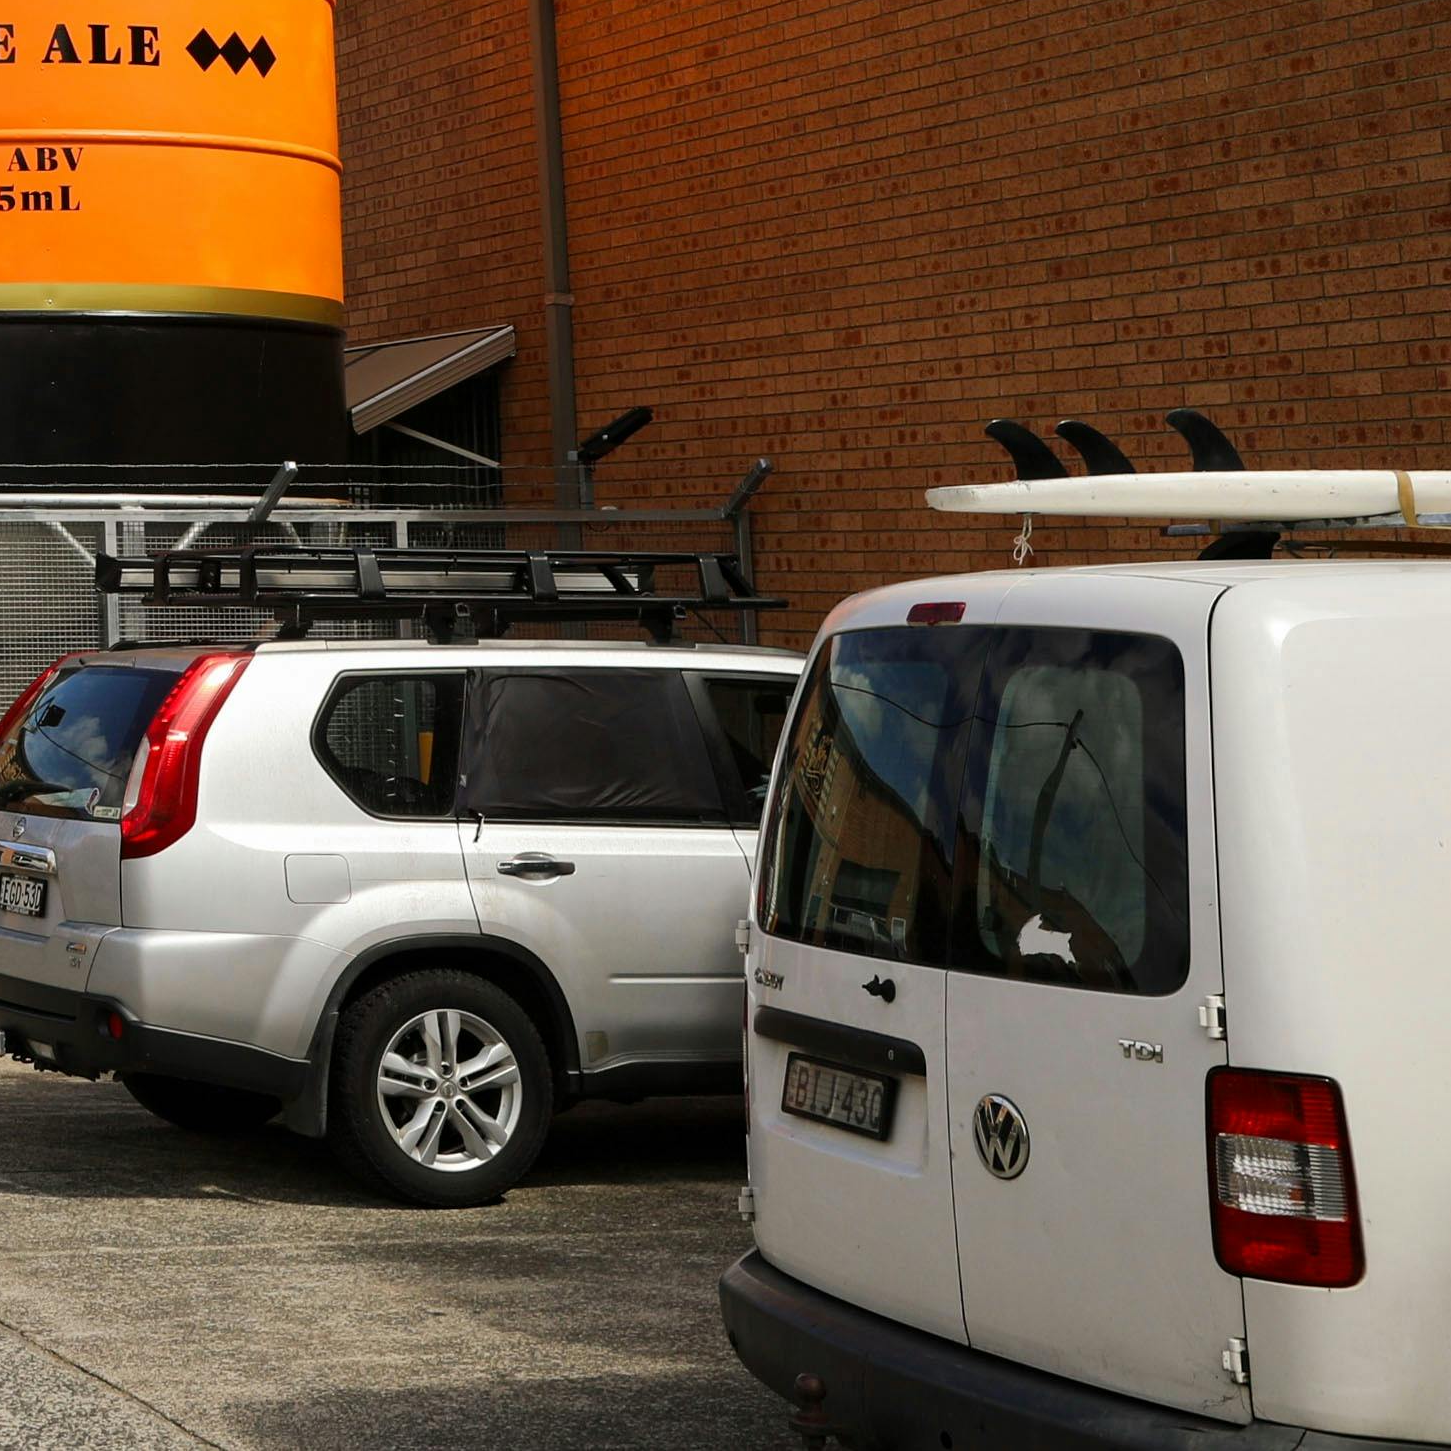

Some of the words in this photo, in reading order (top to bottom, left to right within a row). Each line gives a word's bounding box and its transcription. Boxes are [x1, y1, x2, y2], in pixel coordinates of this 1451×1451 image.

[41, 22, 161, 67] ALE
[6, 146, 85, 173] ABV
[1118, 1039, 1163, 1064] TDI
